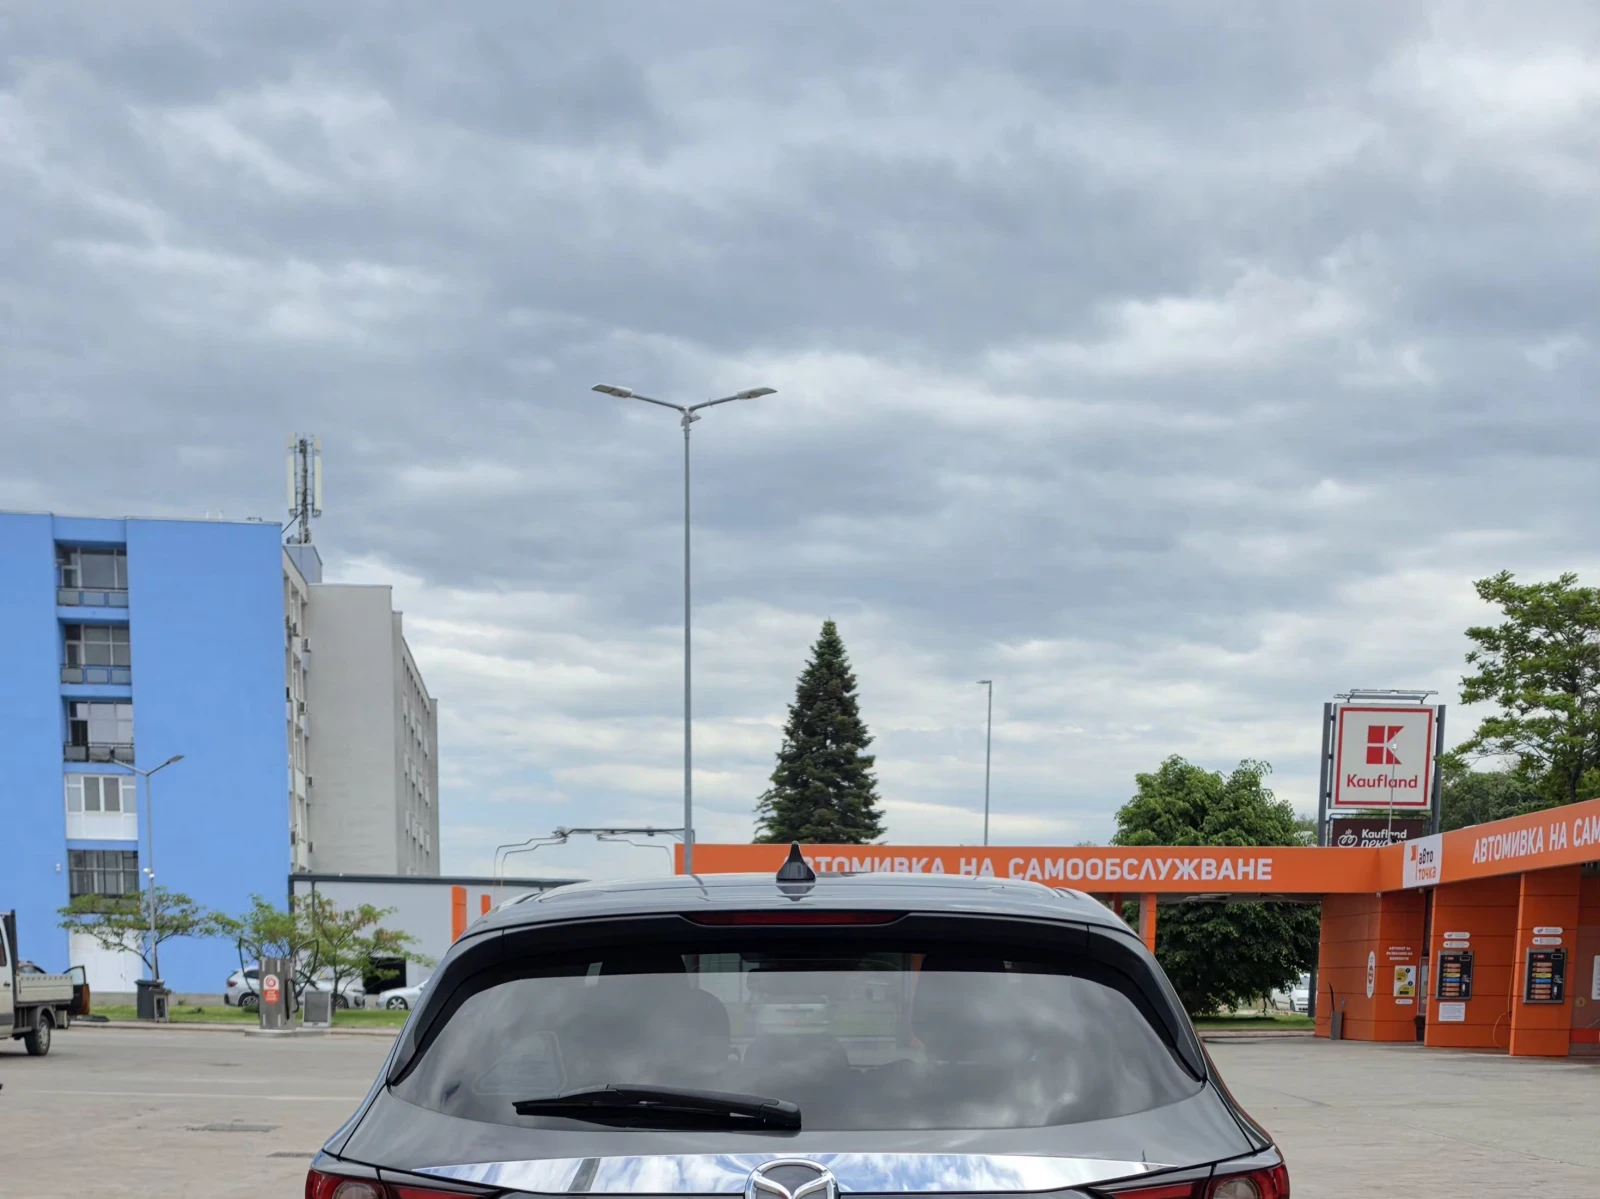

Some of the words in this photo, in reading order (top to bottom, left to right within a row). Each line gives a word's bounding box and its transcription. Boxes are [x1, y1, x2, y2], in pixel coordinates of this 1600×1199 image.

[1346, 774, 1418, 788] Kaufland
[1472, 826, 1544, 864] АВТОМИВКА
[1549, 821, 1567, 851] НА
[1418, 848, 1434, 864] авто
[784, 857, 945, 874] ТОМИВКА
[959, 857, 995, 877] НА
[1008, 857, 1273, 881] САМООБСЛУЖВАНЕ
[1418, 866, 1437, 880] точка
